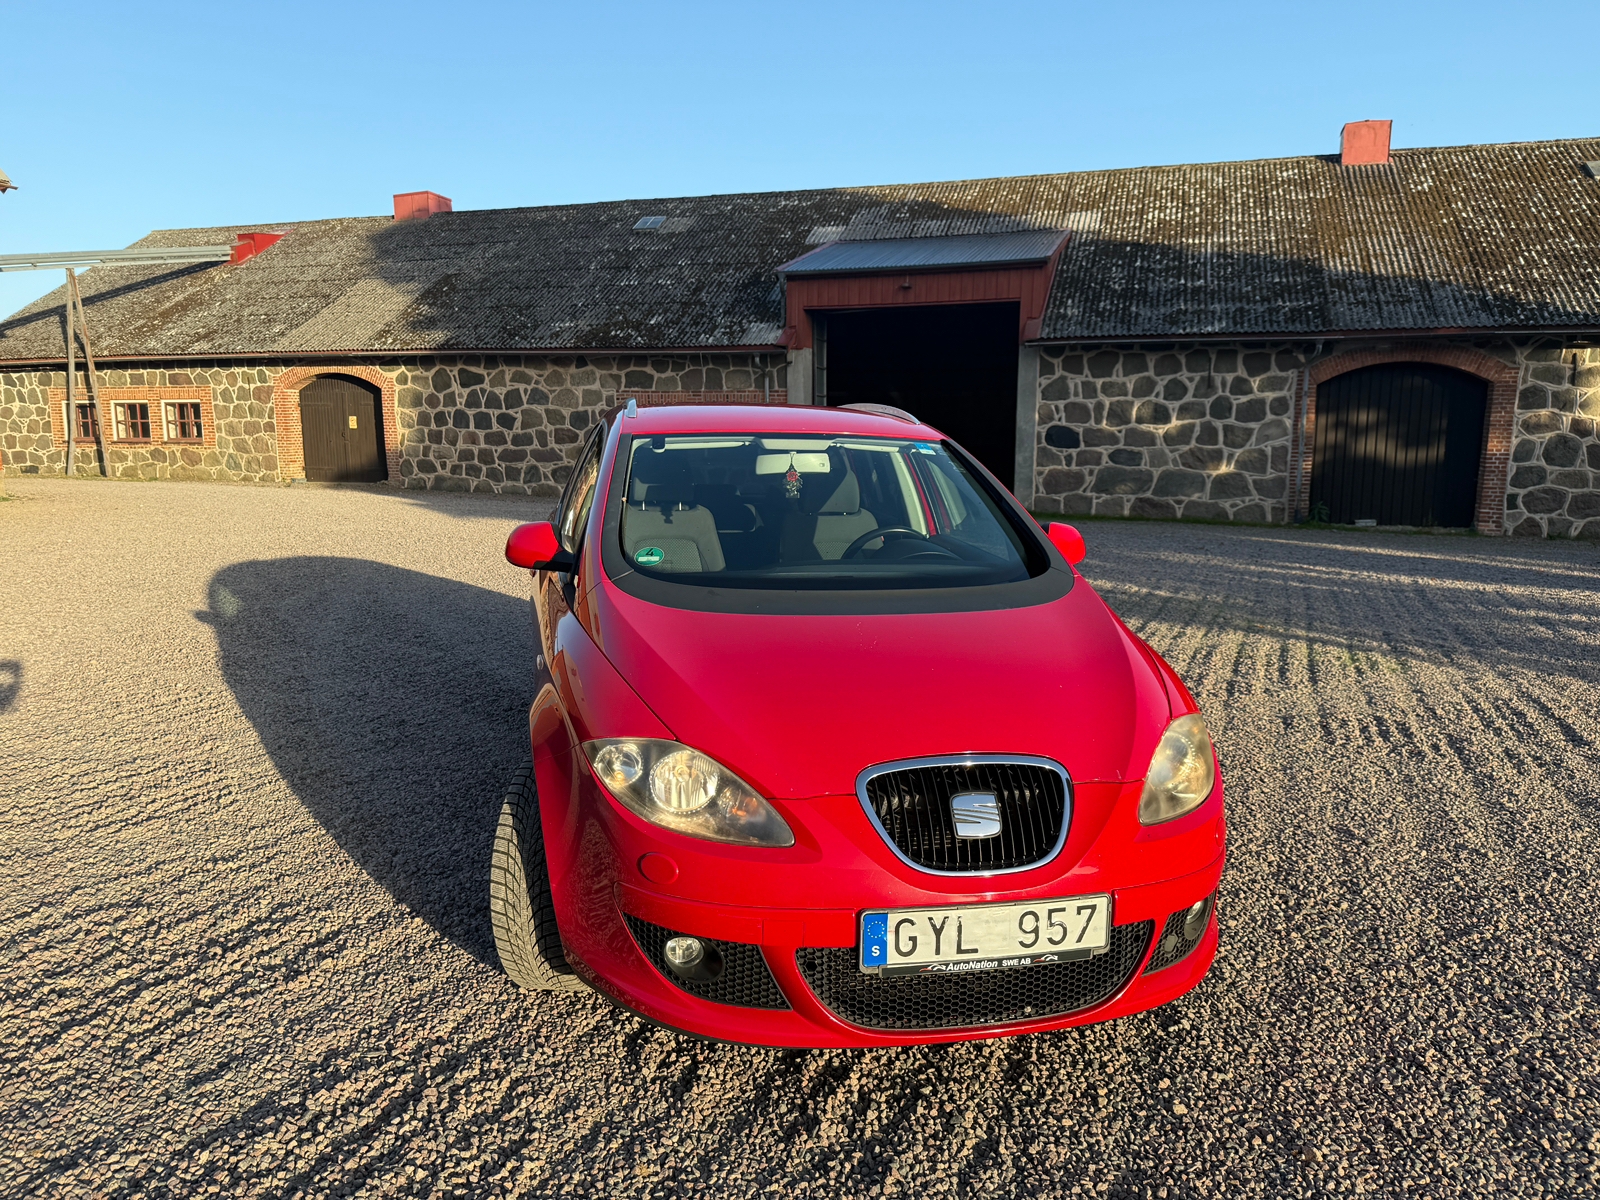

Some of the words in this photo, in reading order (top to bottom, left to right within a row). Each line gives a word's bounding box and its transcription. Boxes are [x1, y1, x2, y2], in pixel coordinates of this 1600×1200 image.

[645, 547, 655, 557] 4
[894, 915, 979, 958] GYL
[1018, 903, 1097, 949] 957
[871, 945, 880, 957] S
[946, 960, 998, 971] AutoNation
[1002, 958, 1019, 967] SWE
[1020, 957, 1031, 966] AB
